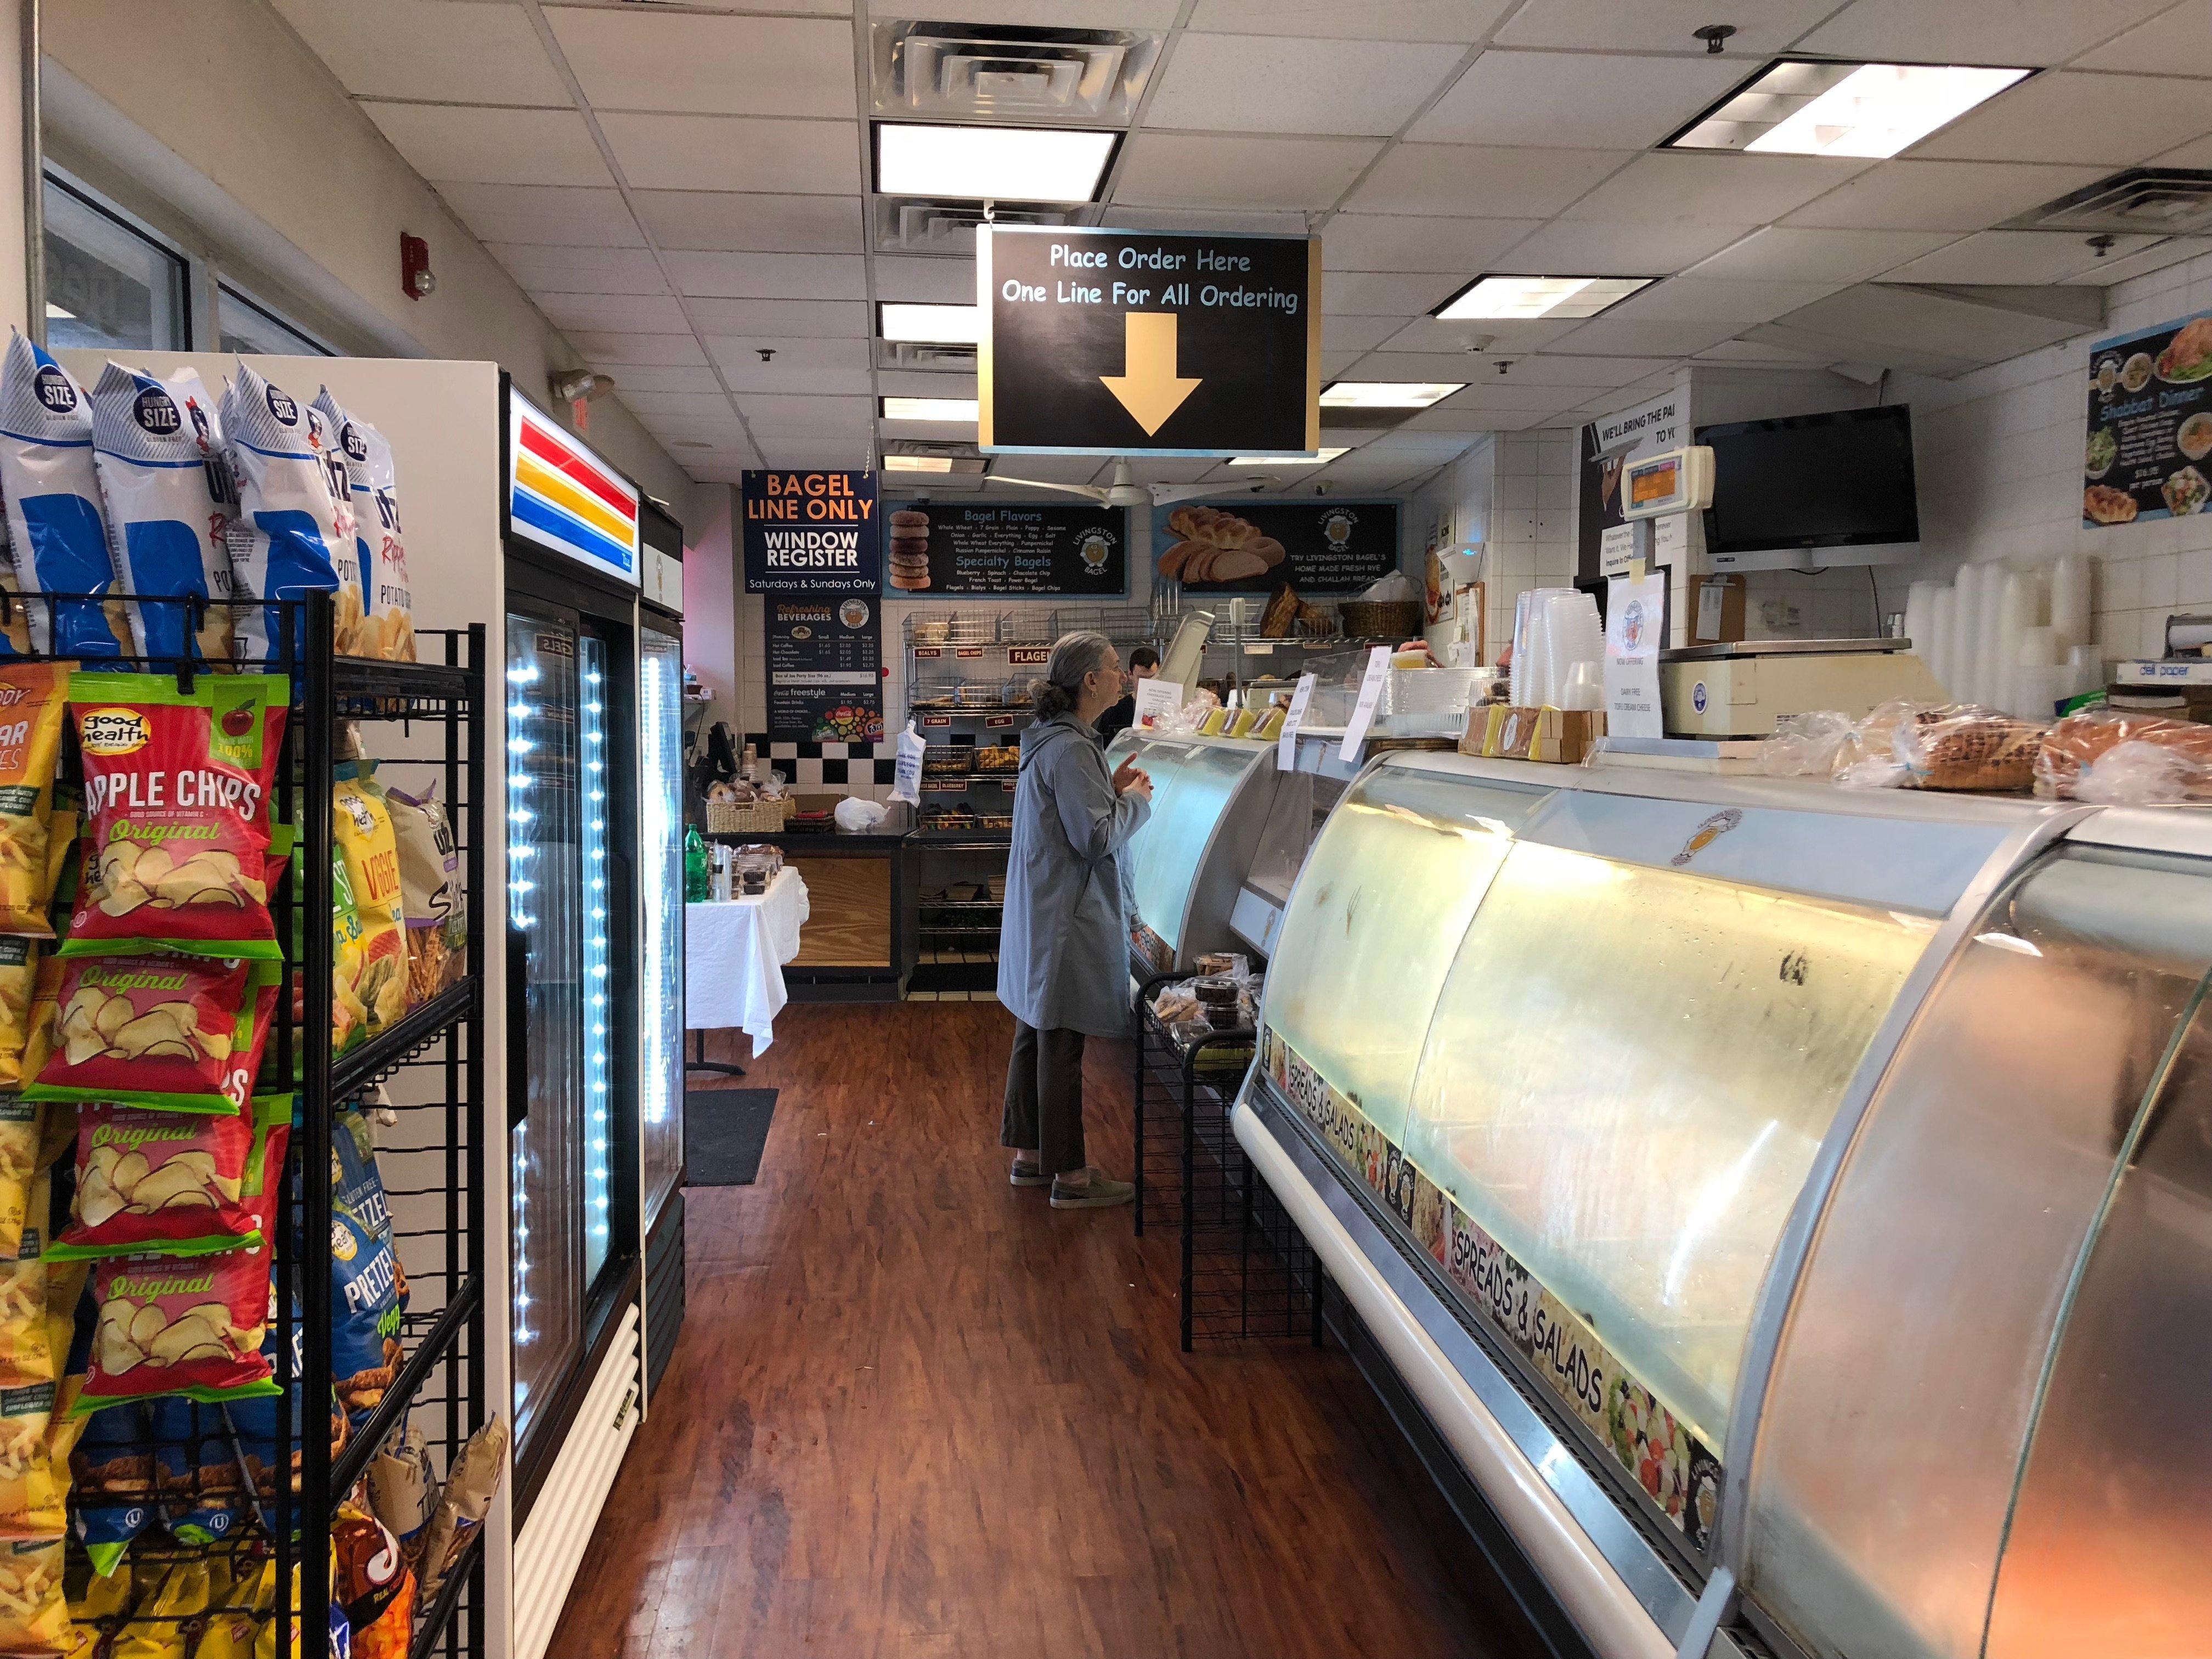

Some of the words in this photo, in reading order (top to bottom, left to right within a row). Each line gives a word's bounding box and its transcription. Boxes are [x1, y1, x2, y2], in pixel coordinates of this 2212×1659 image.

[1050, 244, 1108, 268] Place
[1118, 247, 1186, 270] Order
[1197, 249, 1251, 272] Here
[1002, 279, 1047, 302] One
[1057, 281, 1102, 303] Line
[1113, 281, 1150, 305] For
[1161, 283, 1189, 306] All
[1200, 285, 1298, 315] Ordering
[43, 385, 75, 407] SIZE
[143, 408, 178, 428] SIZE
[273, 399, 296, 423] SIZE
[1602, 424, 1623, 442] WE'LL
[1623, 416, 1646, 436] BRING
[1647, 410, 1662, 428] THE
[1663, 403, 1675, 422] PA
[1656, 428, 1668, 444] TO
[768, 474, 854, 496] BAGEL
[748, 499, 798, 520] LINE
[806, 499, 873, 520] ONLY
[964, 510, 995, 523] Bagel
[1000, 510, 1042, 522] Flavors
[1318, 508, 1359, 525] LIVINGSTON
[764, 532, 859, 549] WINDOW
[1073, 527, 1118, 545] LIVINGSTON
[767, 549, 858, 567] REGISTER
[956, 555, 1009, 569] Specialty
[1014, 556, 1053, 569] Bagels
[1084, 567, 1108, 575] BAGEL
[749, 579, 798, 590] Saturdays
[800, 580, 808, 588] &
[810, 579, 850, 590] Sundays
[854, 579, 876, 590] Only
[776, 603, 832, 616] Refreshing
[777, 613, 832, 622] BEVERAGES
[790, 687, 826, 699] freestyle
[84, 715, 144, 732] good
[218, 743, 253, 760] 100%
[84, 771, 166, 822] APPLE
[177, 770, 261, 822] CHIPS
[109, 819, 221, 846] Original
[79, 965, 189, 995] Original
[1291, 1064, 1317, 1111] SPREADS
[1318, 1091, 1324, 1118] &
[1325, 1099, 1355, 1150] SALADS
[91, 1120, 198, 1151] Original
[107, 1273, 215, 1305] Original
[1455, 1231, 1513, 1316] SPREADS
[1518, 1290, 1528, 1336] &
[1534, 1309, 1602, 1413] SALADS
